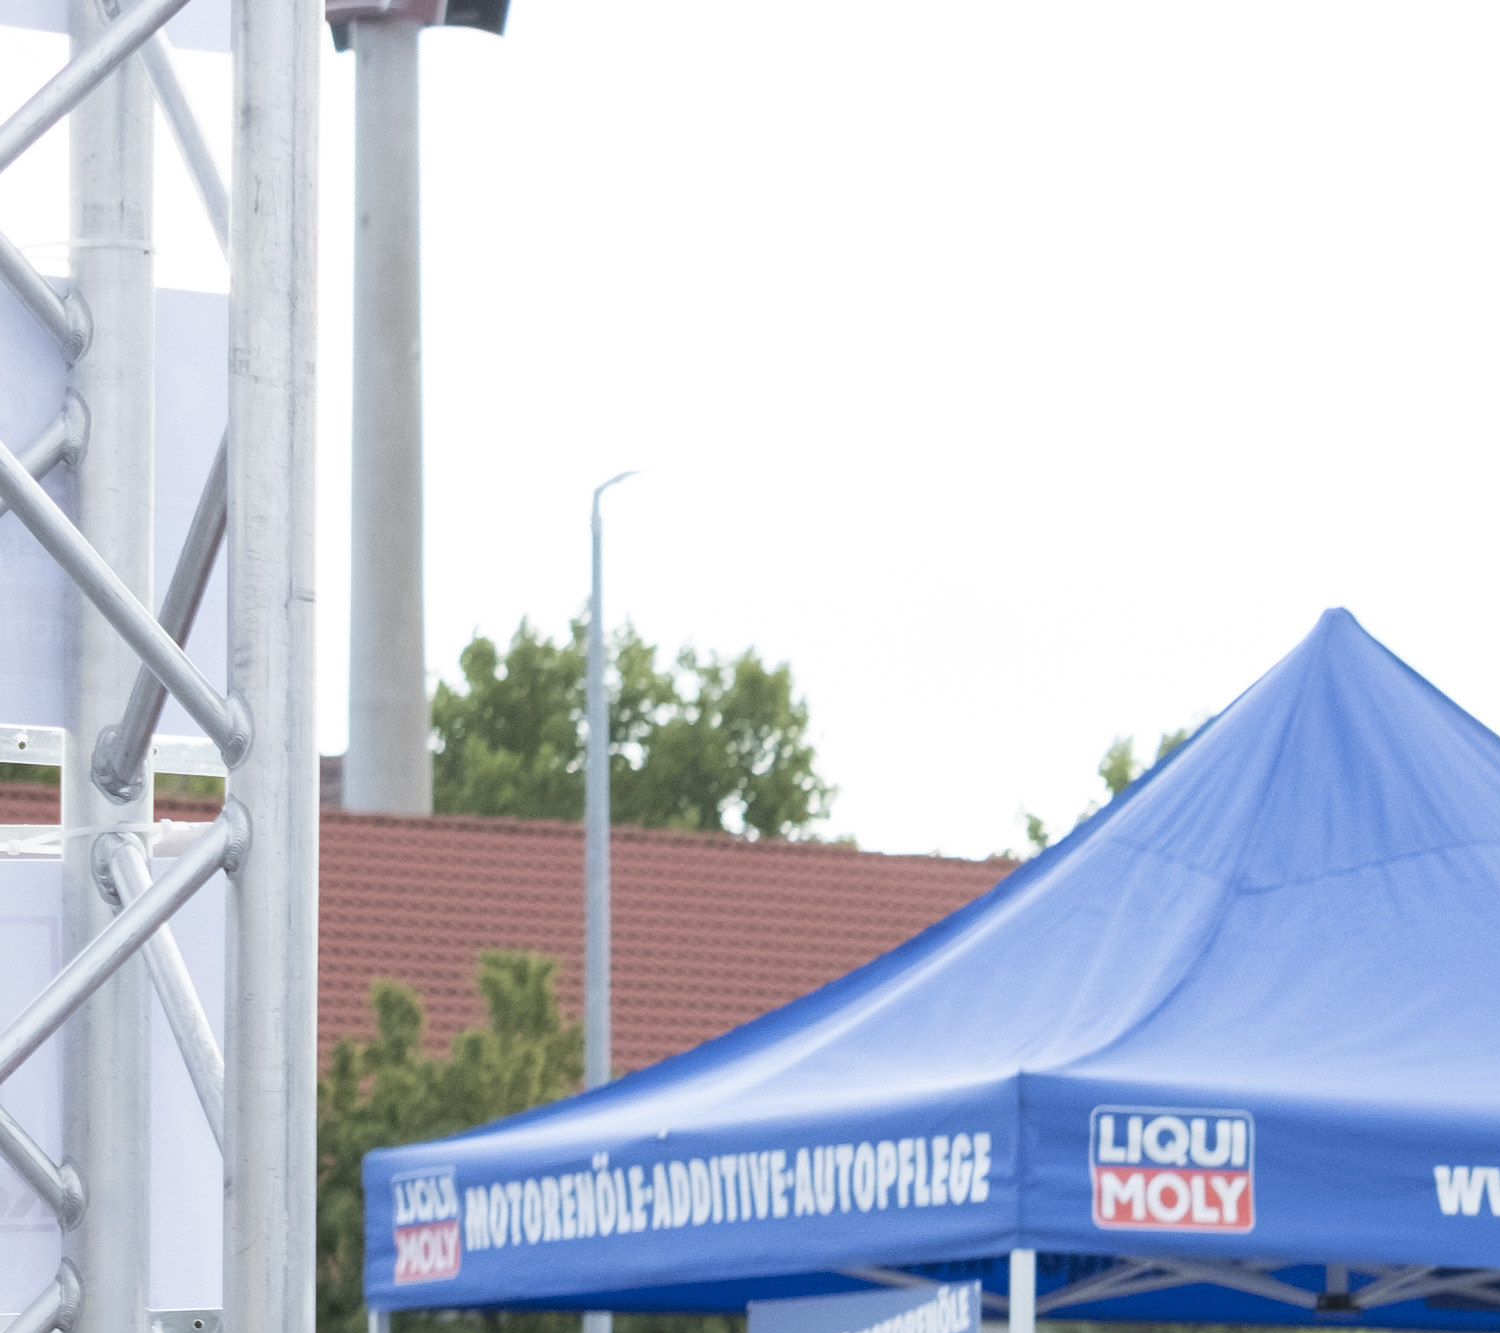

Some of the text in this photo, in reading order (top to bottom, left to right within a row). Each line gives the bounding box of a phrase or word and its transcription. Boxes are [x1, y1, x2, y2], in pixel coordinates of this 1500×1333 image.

[1099, 1115, 1246, 1168] LIQUI
[1100, 1170, 1248, 1224] MOLY
[397, 1227, 459, 1276] MOLY
